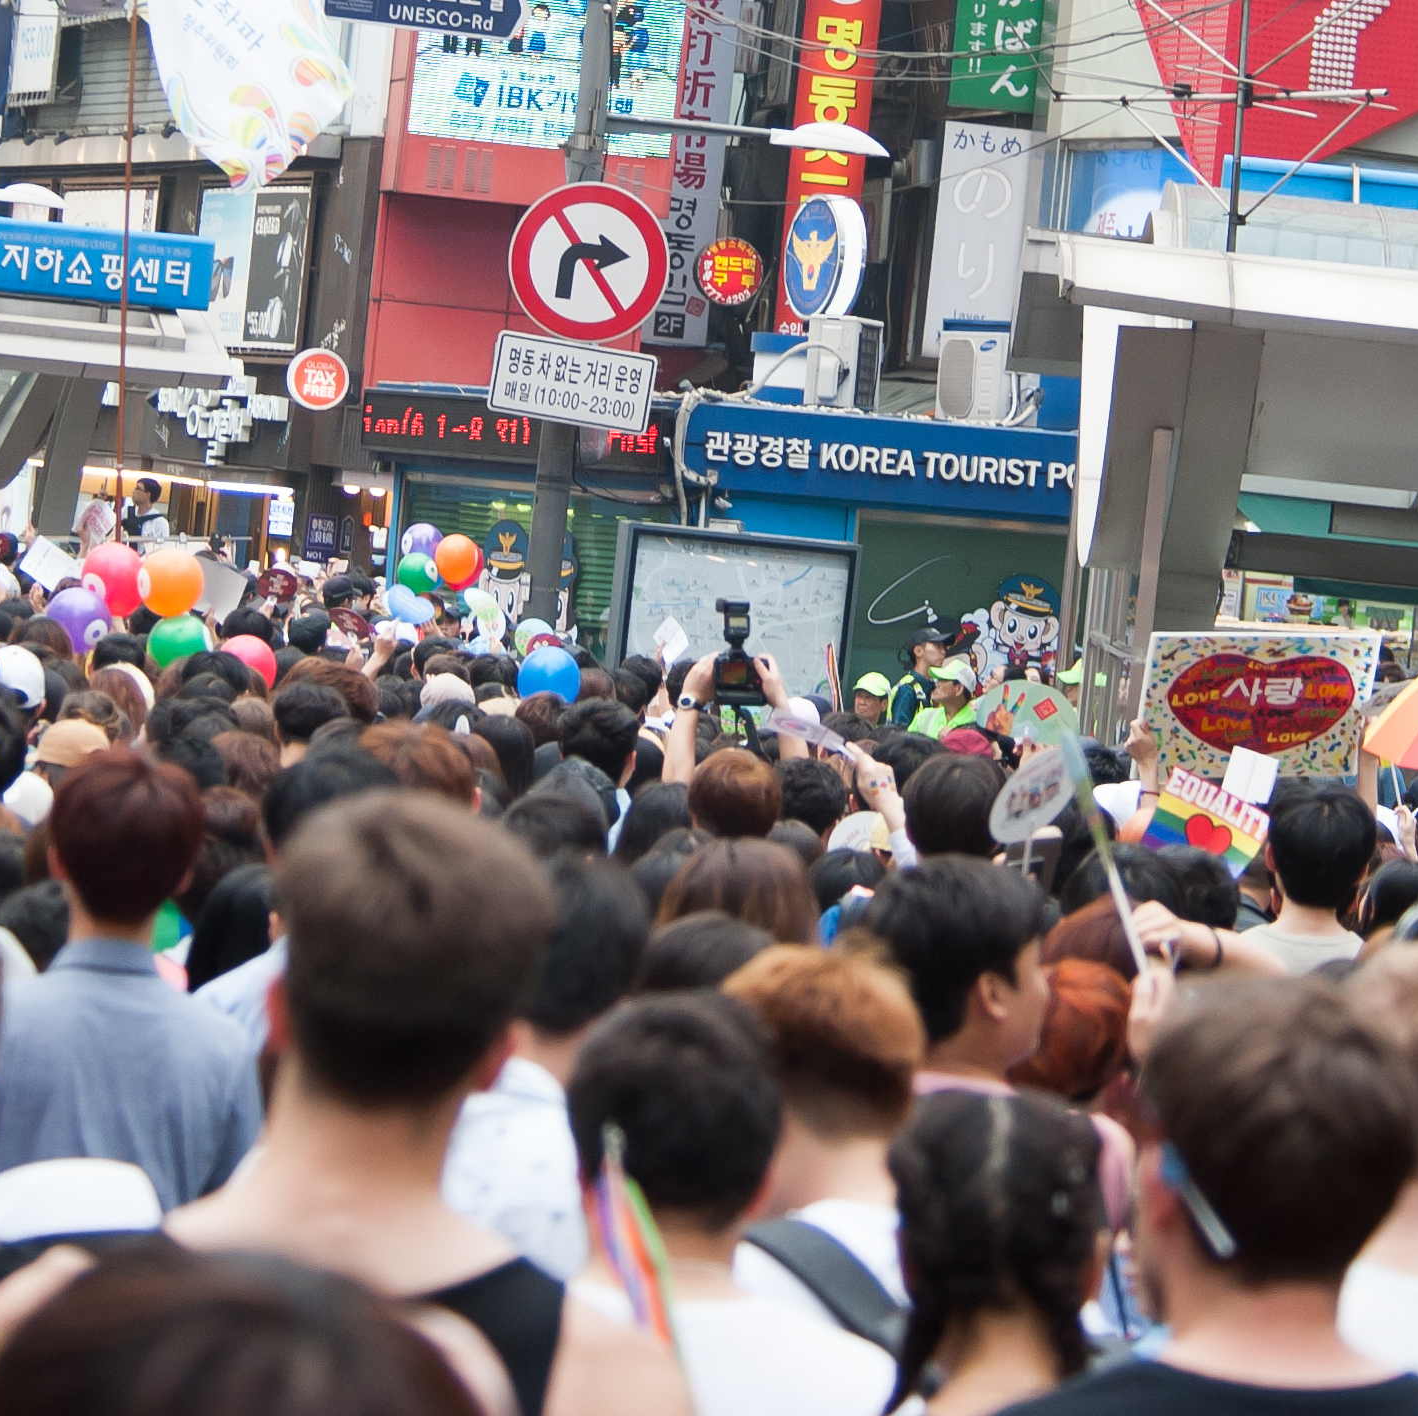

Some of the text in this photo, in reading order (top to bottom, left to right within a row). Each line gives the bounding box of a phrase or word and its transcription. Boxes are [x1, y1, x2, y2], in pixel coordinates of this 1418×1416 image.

[388, 3, 494, 32] UNESCO-Rd
[952, 128, 1023, 158] かもめ
[952, 167, 1013, 299] のり
[714, 255, 756, 272] 핸드백
[303, 369, 337, 385] TAX
[306, 360, 338, 372] GLOBAL
[508, 347, 643, 396] 명동 차 없는 거리 운영
[303, 384, 336, 399] FREE
[503, 380, 636, 421] 매일 (10:00~23:00)
[248, 395, 279, 421] FASHION
[705, 430, 812, 470] 관광경찰
[819, 442, 917, 477] KOREA
[923, 450, 1042, 486] TOURIST
[1171, 689, 1220, 708] LOVE
[1222, 677, 1304, 707] 사랑
[1305, 683, 1350, 699] LOVE
[1201, 716, 1253, 732] LOVE
[1166, 767, 1270, 838] EQUALITY
